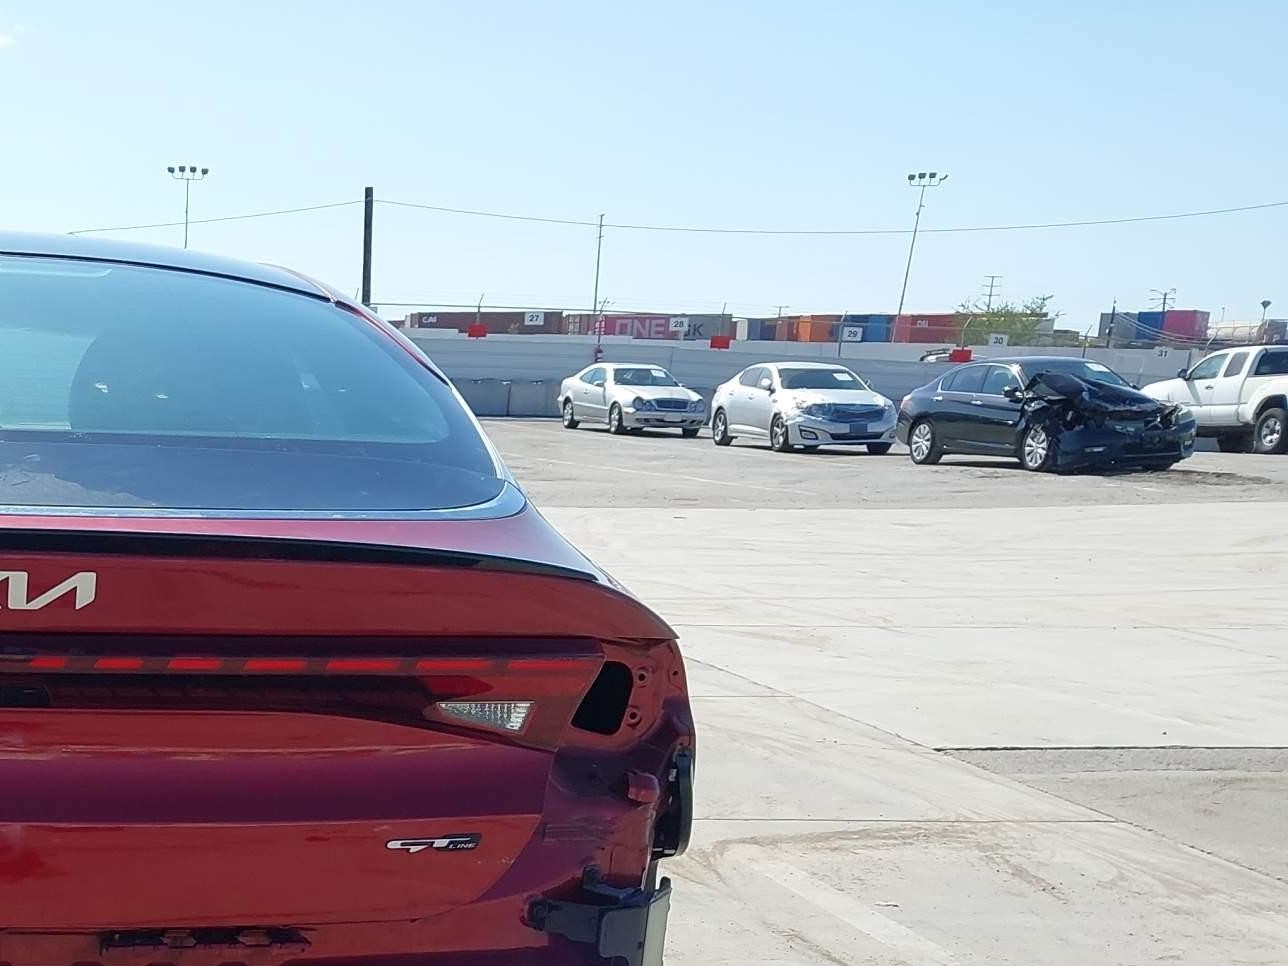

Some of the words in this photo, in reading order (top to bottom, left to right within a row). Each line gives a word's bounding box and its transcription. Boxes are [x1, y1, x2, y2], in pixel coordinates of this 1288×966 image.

[528, 314, 540, 322] 27
[673, 320, 684, 328] 28
[615, 319, 665, 338] ONE
[847, 330, 858, 338] 29
[993, 336, 1004, 345] 30
[386, 837, 472, 854] GT
